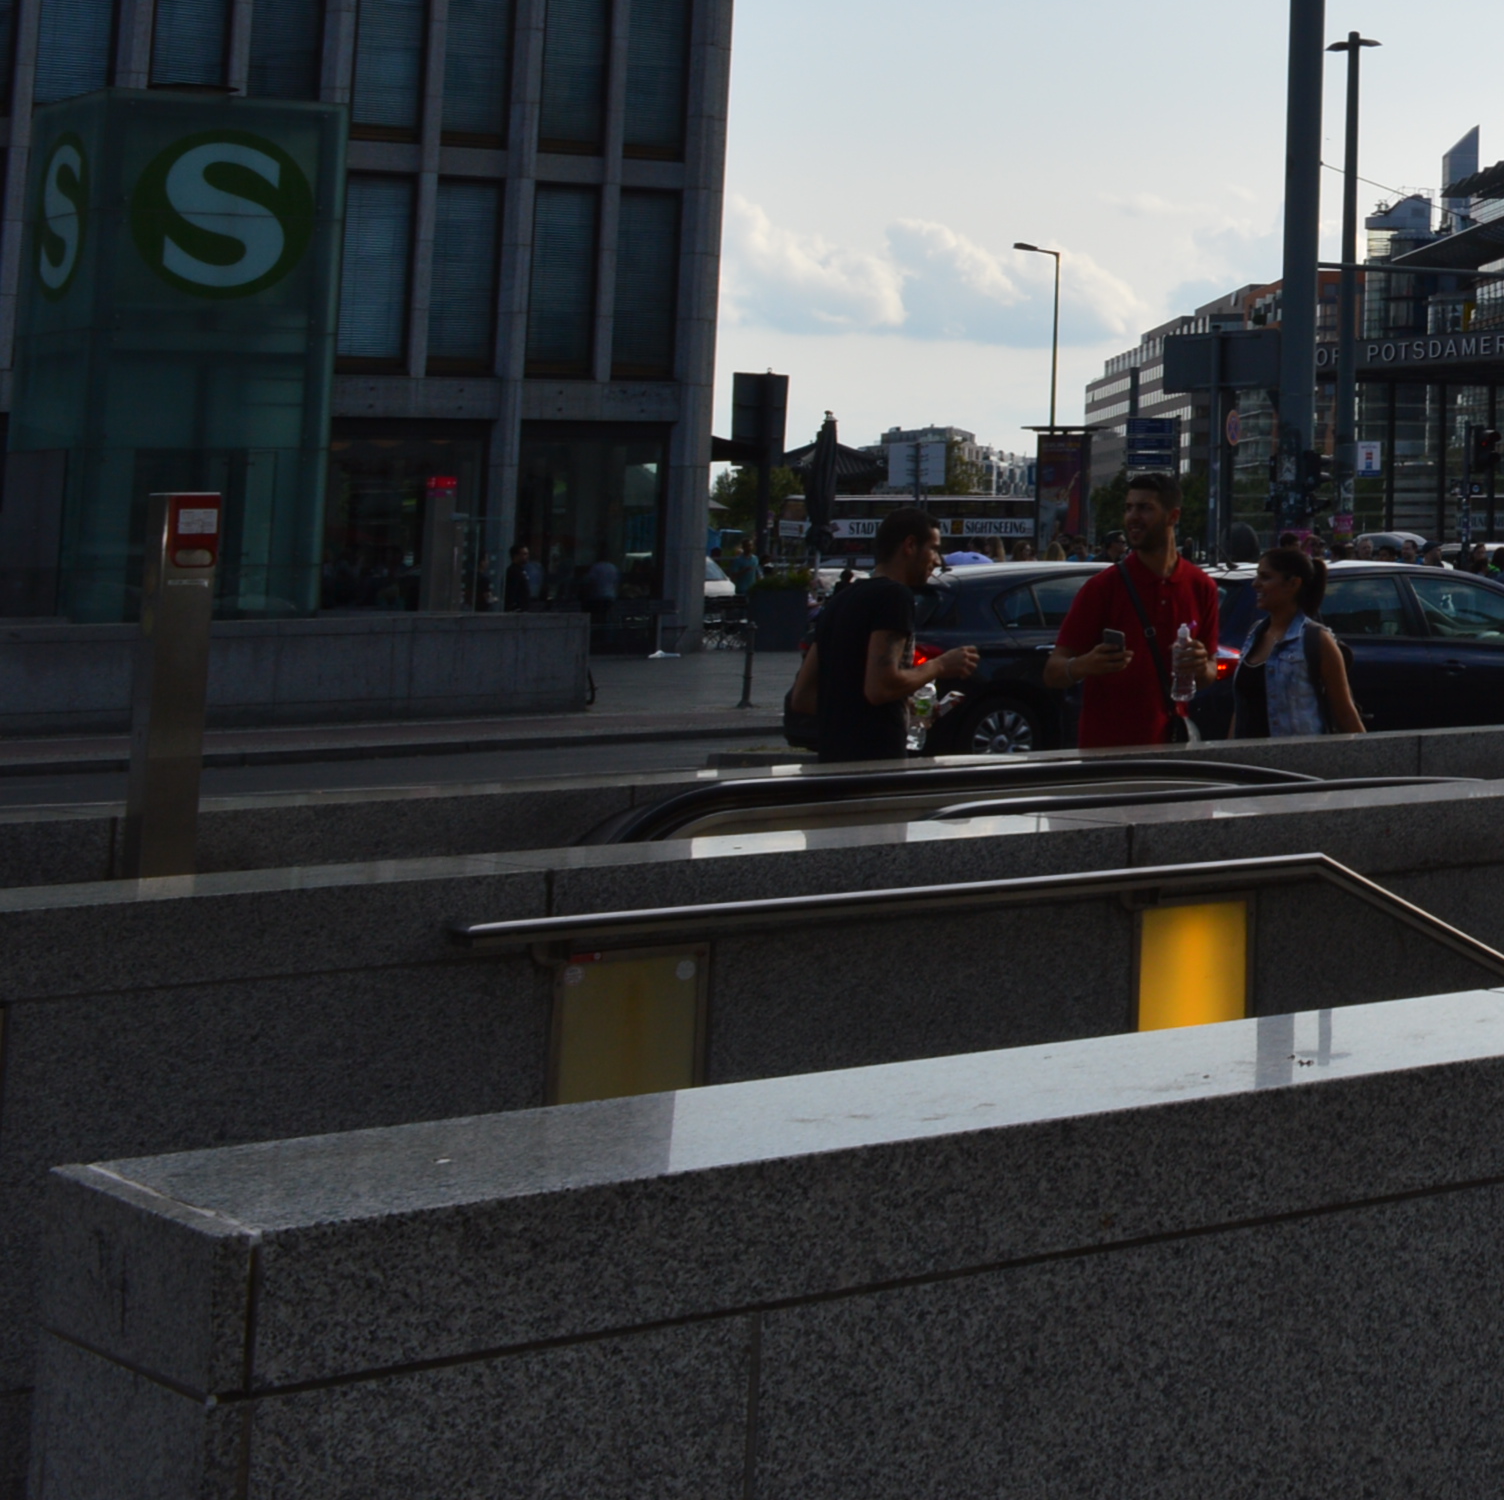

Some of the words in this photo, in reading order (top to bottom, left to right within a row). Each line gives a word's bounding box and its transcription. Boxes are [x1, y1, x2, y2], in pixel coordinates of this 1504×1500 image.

[39, 144, 81, 290] S
[162, 142, 285, 287] S
[965, 520, 1026, 535] SIGHTSEEING
